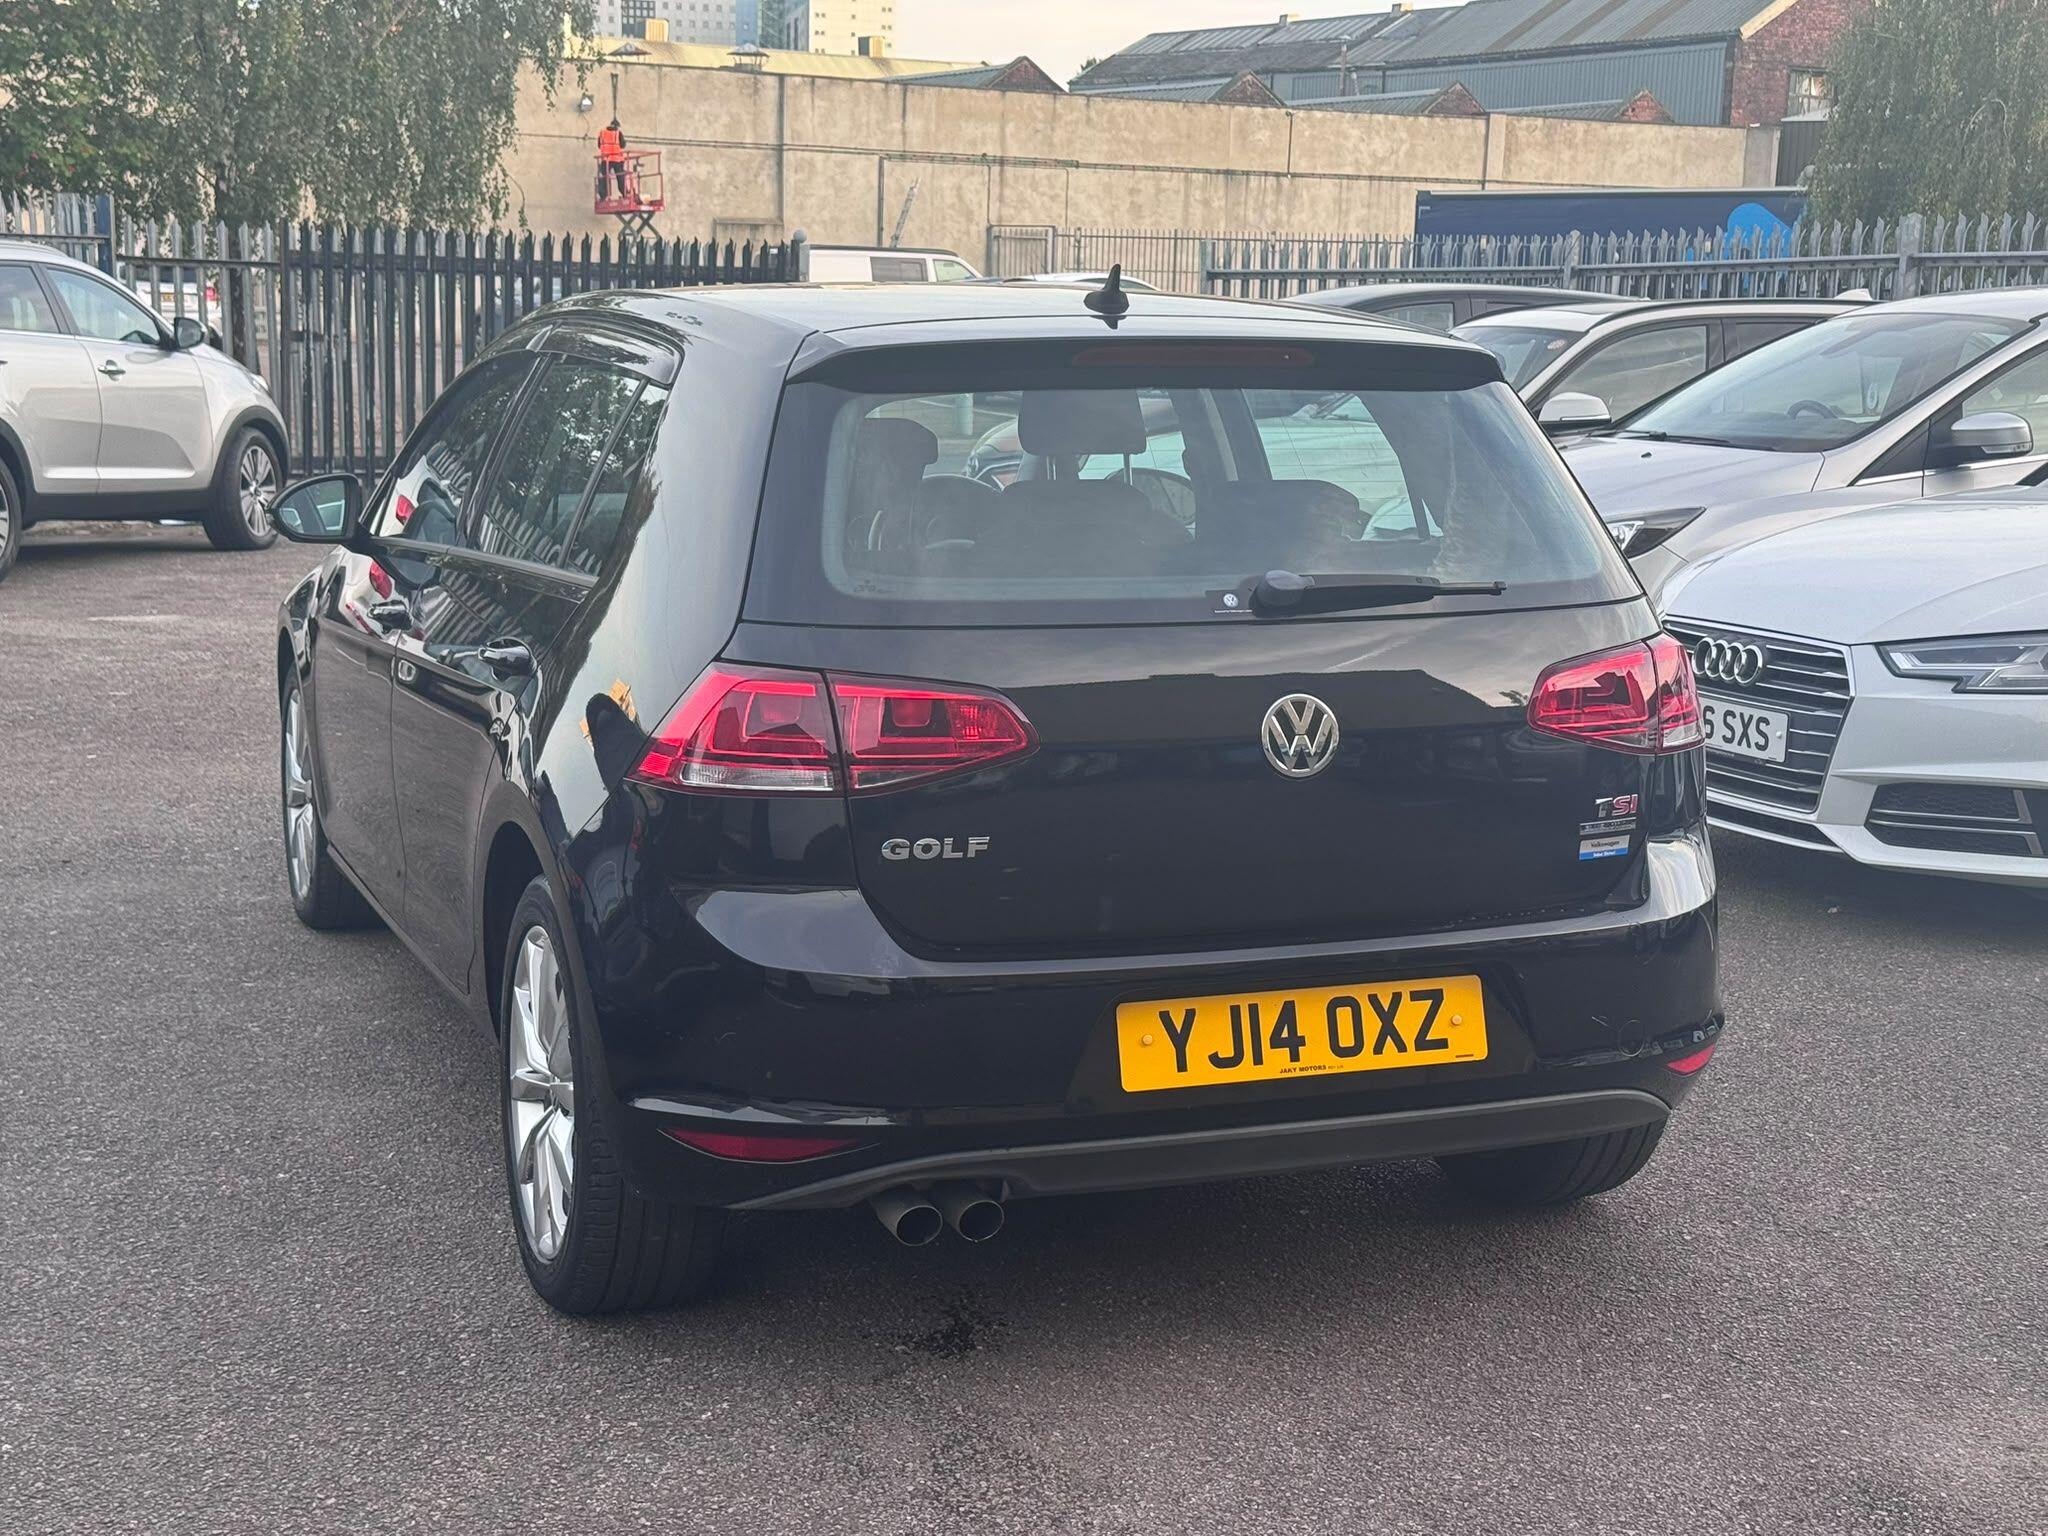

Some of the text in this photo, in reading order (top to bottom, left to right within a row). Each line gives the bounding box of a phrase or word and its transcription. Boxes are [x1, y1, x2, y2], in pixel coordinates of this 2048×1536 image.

[1722, 709, 1770, 752] SXS
[1594, 794, 1638, 818] TSI
[881, 836, 990, 860] GOLF
[1158, 988, 1449, 1073] YJ14 OXZ
[1298, 1064, 1327, 1072] MOTORS
